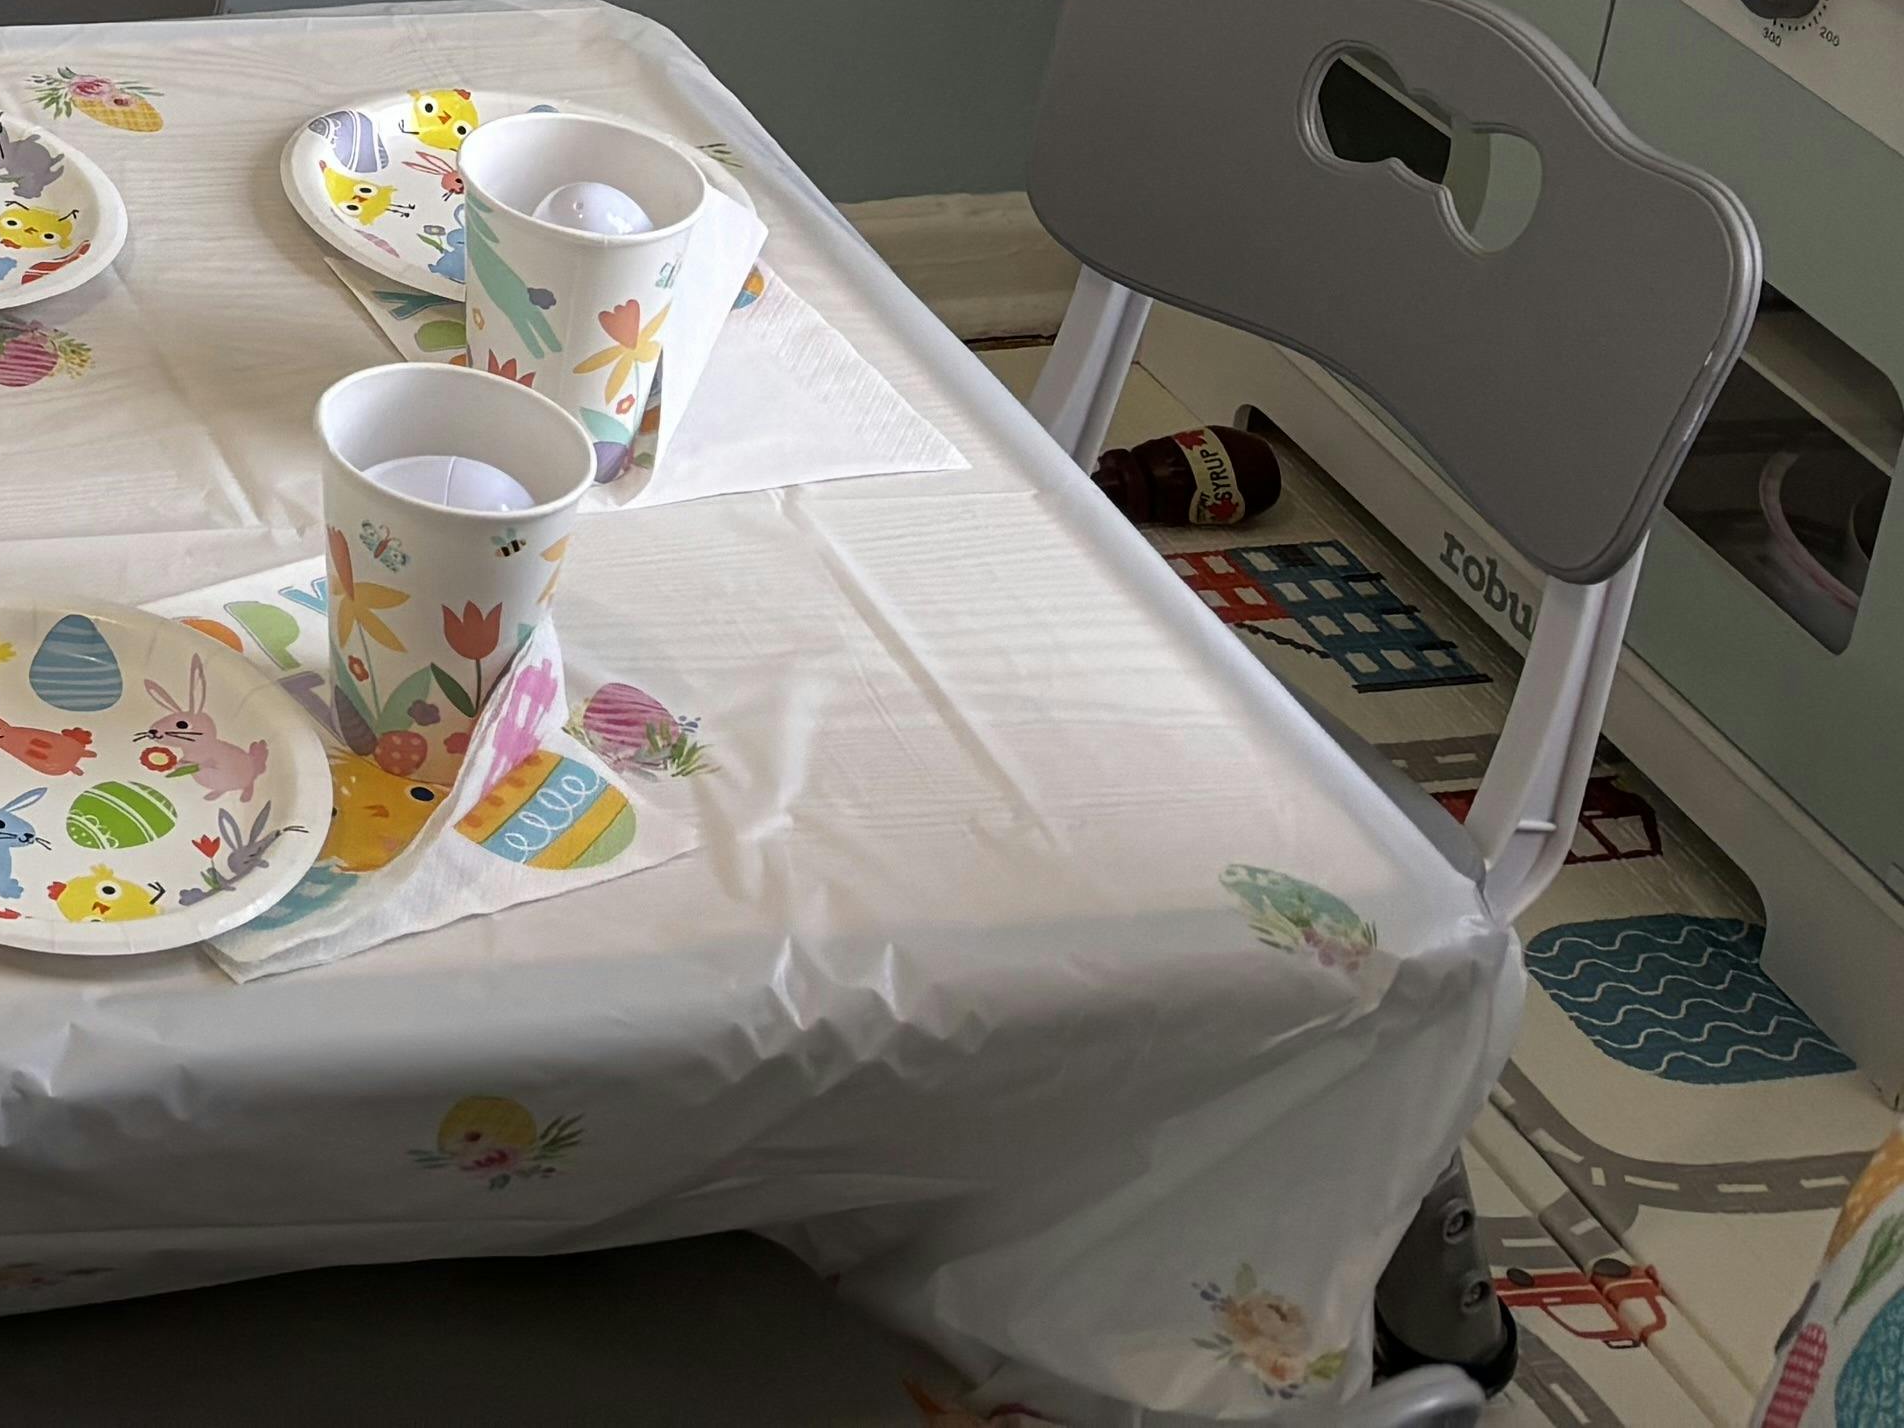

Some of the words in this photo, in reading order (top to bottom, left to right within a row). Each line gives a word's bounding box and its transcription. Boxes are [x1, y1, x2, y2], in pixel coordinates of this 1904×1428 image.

[1762, 27, 1782, 48] 300
[1819, 25, 1840, 47] 200
[1199, 448, 1233, 503] SYRUP
